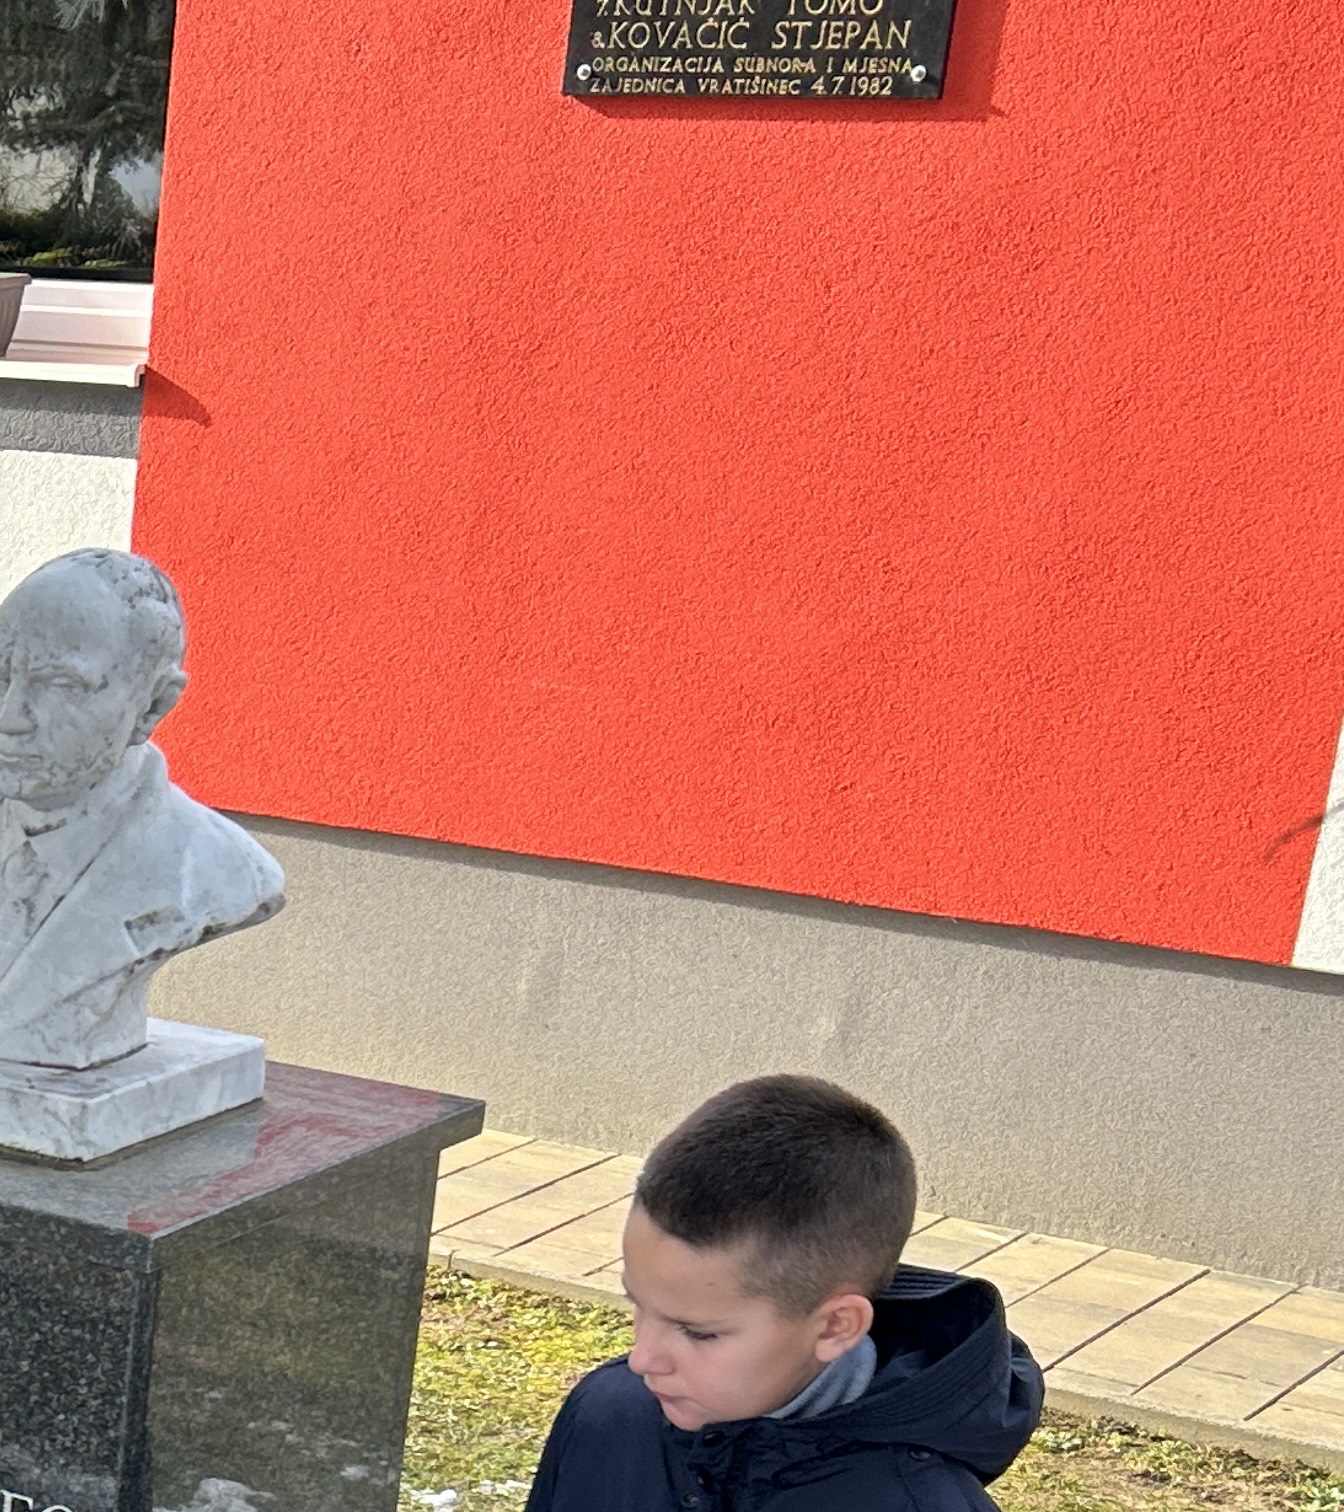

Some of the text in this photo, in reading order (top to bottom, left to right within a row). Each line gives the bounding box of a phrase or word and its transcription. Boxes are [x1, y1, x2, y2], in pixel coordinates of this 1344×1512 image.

[771, 20, 912, 49] STJEPAN
[592, 55, 725, 74] ORGANIZACIJA
[826, 57, 834, 74] I
[842, 56, 913, 75] MJESNA
[590, 77, 686, 94] ZAJEDNICA
[697, 76, 802, 95] VRATIŠINEC
